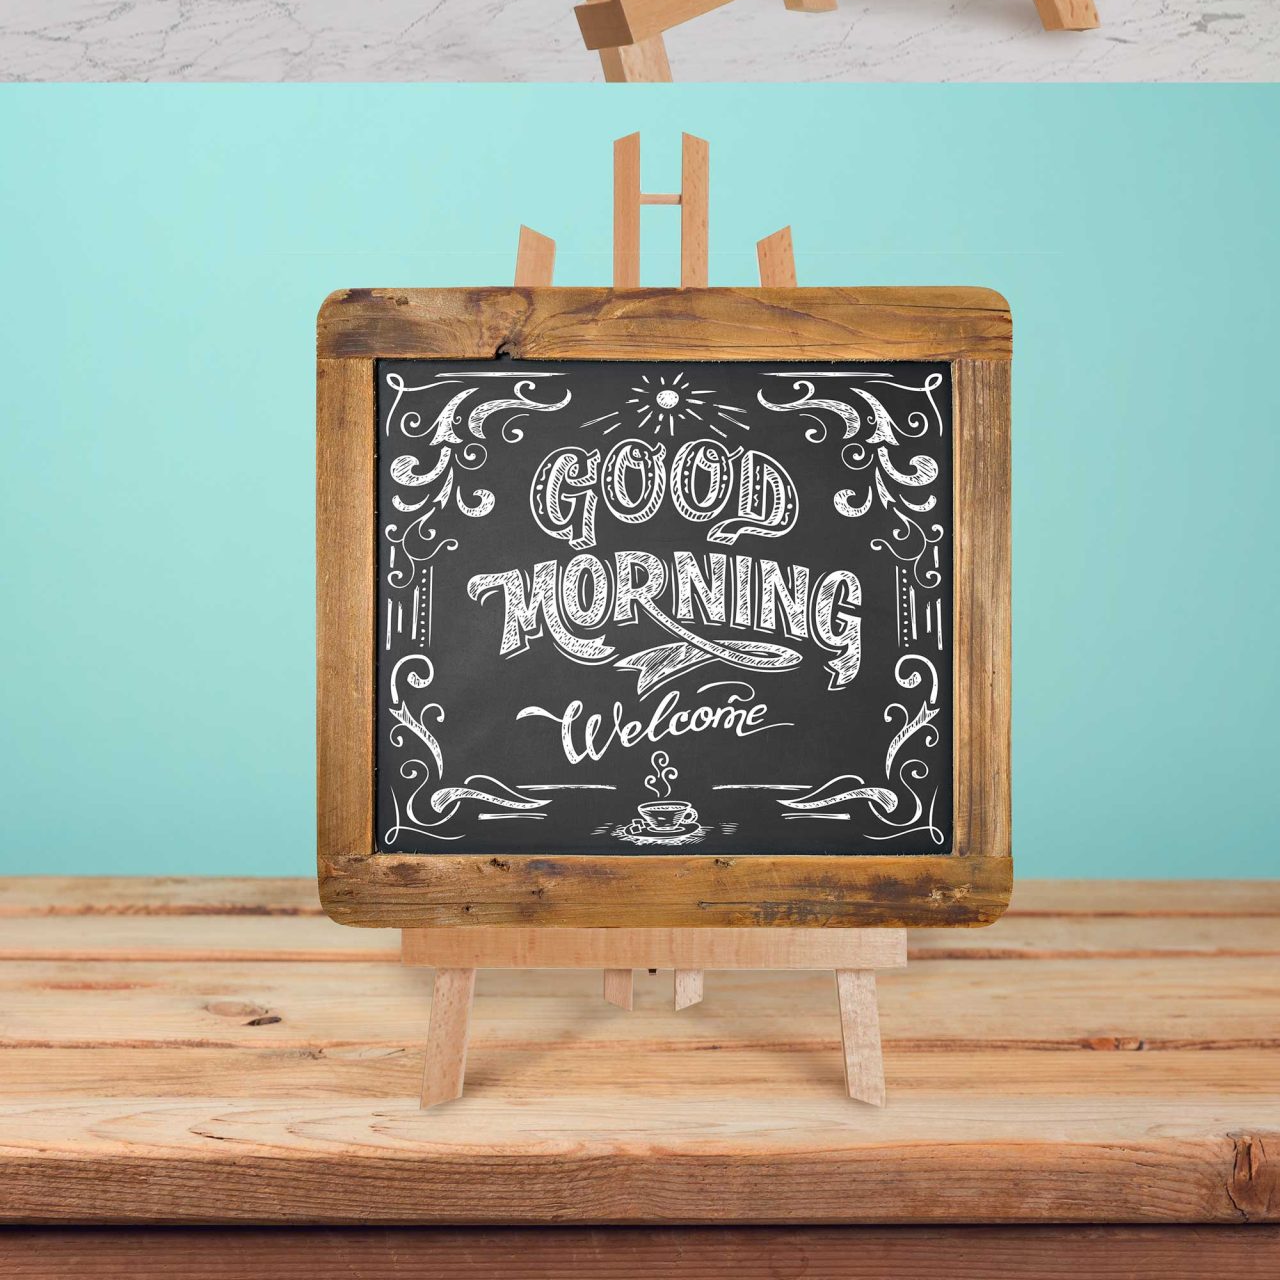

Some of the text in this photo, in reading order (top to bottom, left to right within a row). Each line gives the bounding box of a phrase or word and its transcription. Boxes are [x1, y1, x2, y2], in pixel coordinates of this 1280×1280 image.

[529, 438, 800, 550] GOOD
[466, 550, 863, 701] MORNING
[515, 681, 796, 766] Welcome
